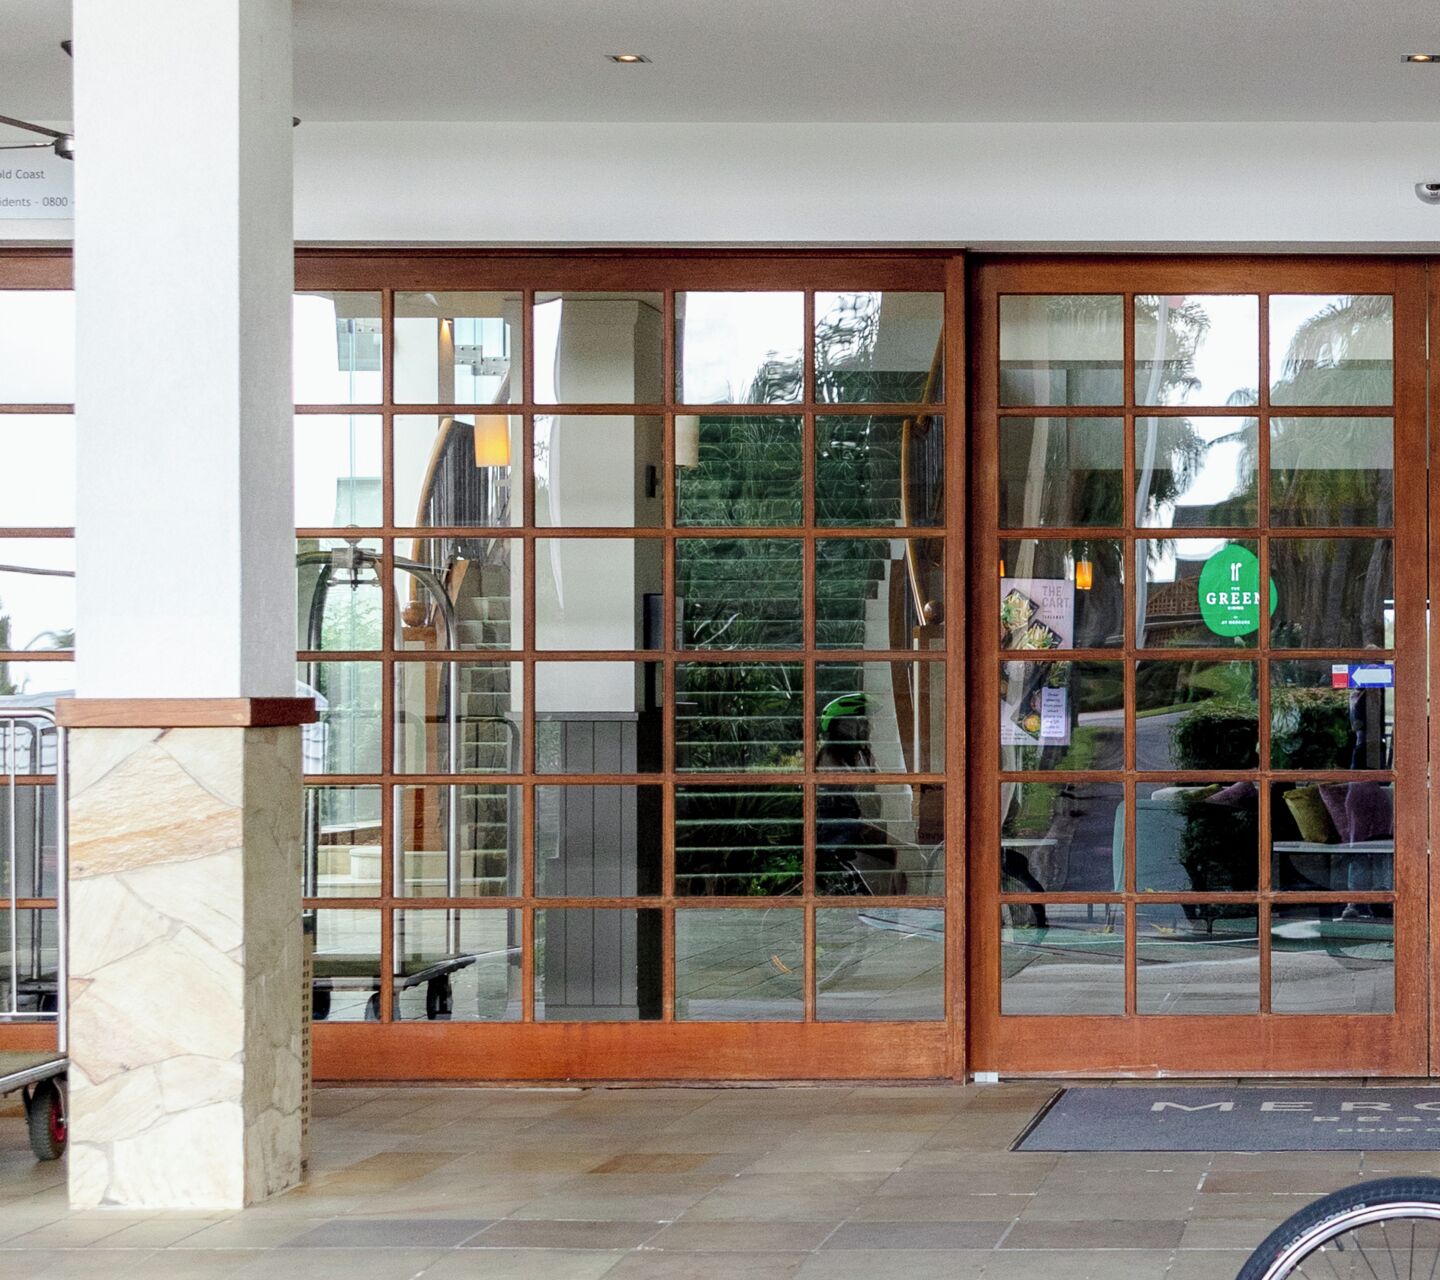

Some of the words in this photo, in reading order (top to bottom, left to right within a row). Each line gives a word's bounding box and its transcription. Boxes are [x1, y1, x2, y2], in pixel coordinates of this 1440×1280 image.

[15, 169, 46, 180] Coast
[42, 196, 69, 207] 0800
[1042, 585, 1062, 597] THE
